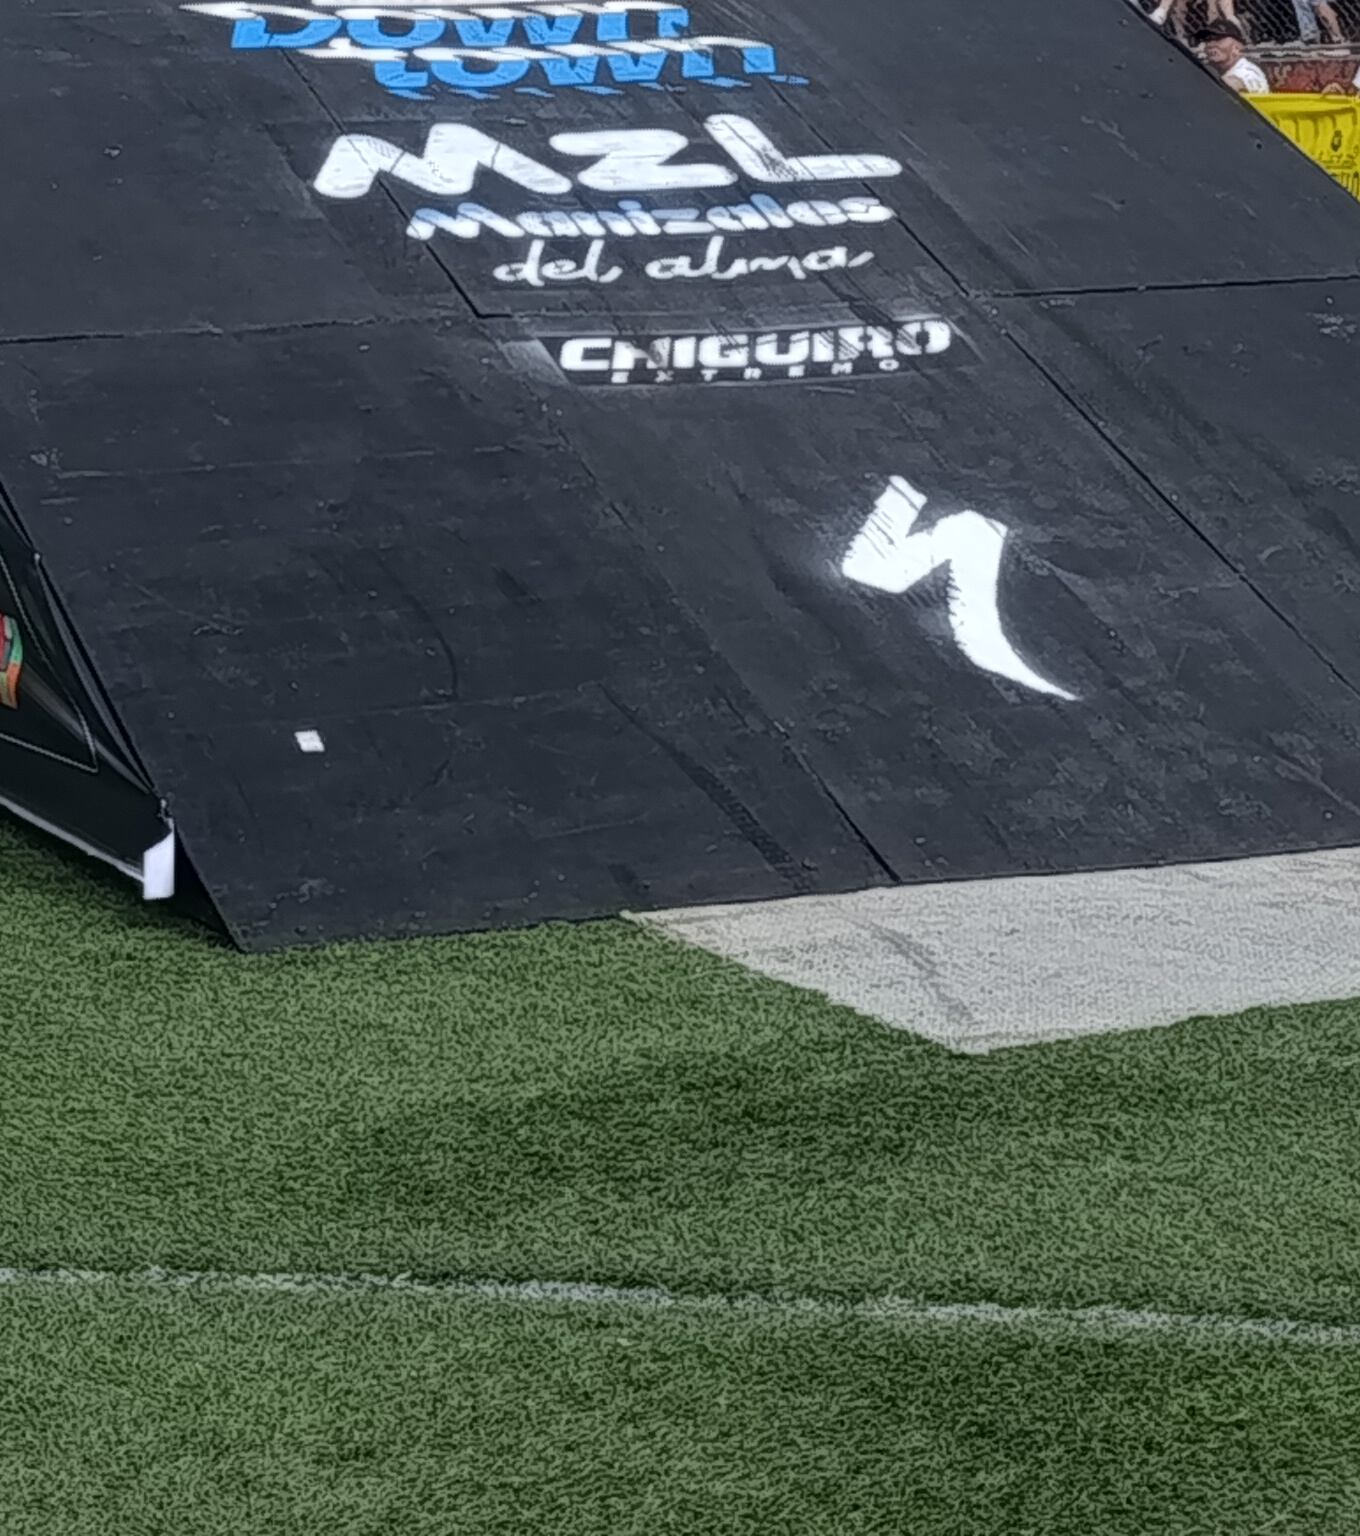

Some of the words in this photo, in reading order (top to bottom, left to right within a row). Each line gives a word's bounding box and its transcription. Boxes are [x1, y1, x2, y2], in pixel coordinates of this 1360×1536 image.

[312, 112, 904, 200] MZL
[492, 238, 624, 288] del
[645, 234, 876, 281] alma
